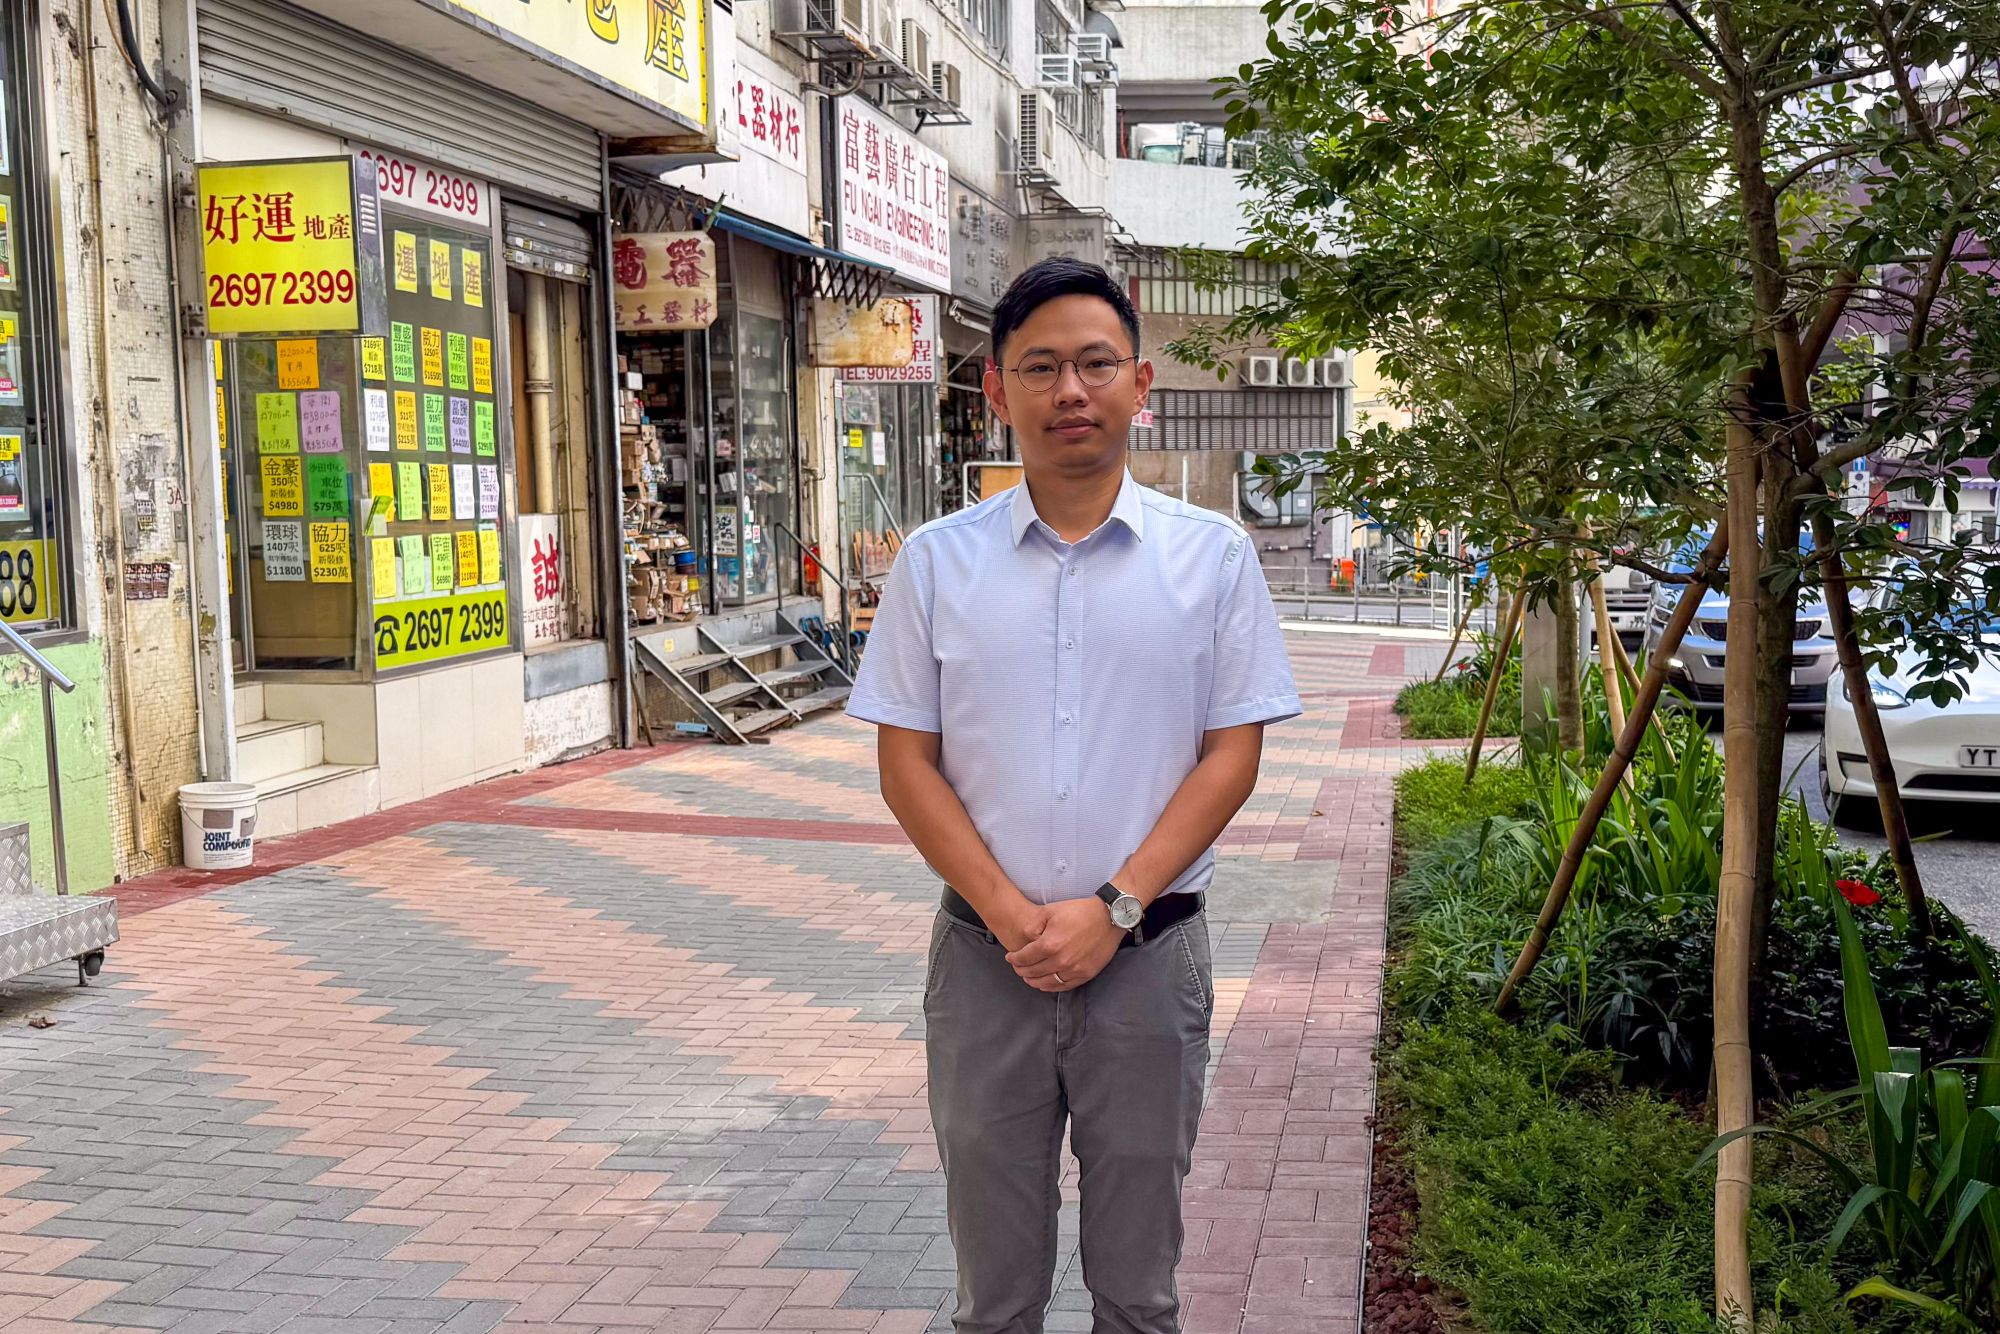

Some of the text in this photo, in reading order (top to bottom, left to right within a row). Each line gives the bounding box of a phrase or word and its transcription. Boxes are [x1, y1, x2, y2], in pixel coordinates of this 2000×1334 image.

[842, 107, 947, 221] 富藝廣告工程
[361, 151, 478, 216] 697 2399
[204, 191, 350, 245] 好運 地產
[843, 180, 857, 216] FU
[861, 191, 882, 227] NGAI
[887, 202, 934, 250] ENGINEERING
[209, 269, 354, 307] 2697 2399
[869, 367, 897, 380] 9012
[900, 366, 932, 380] 9255
[264, 458, 299, 477] 金豪
[271, 477, 297, 488] 350呎
[322, 477, 343, 489] 車位
[167, 487, 183, 505] 3A
[269, 501, 299, 511] $4980
[314, 501, 343, 512] $79萬
[265, 524, 299, 541] 環球
[312, 524, 347, 542] 協力
[266, 542, 299, 553] 1407呎
[319, 543, 346, 554] 625呎
[266, 566, 302, 576] $11800
[314, 566, 349, 578] $230萬
[531, 533, 565, 603] 誠
[0, 549, 37, 617] 88
[404, 607, 454, 651] 2697
[460, 600, 504, 643] 2399
[1967, 748, 1997, 765] YT
[203, 831, 231, 842] JOINT
[203, 838, 251, 851] COMPOUND
